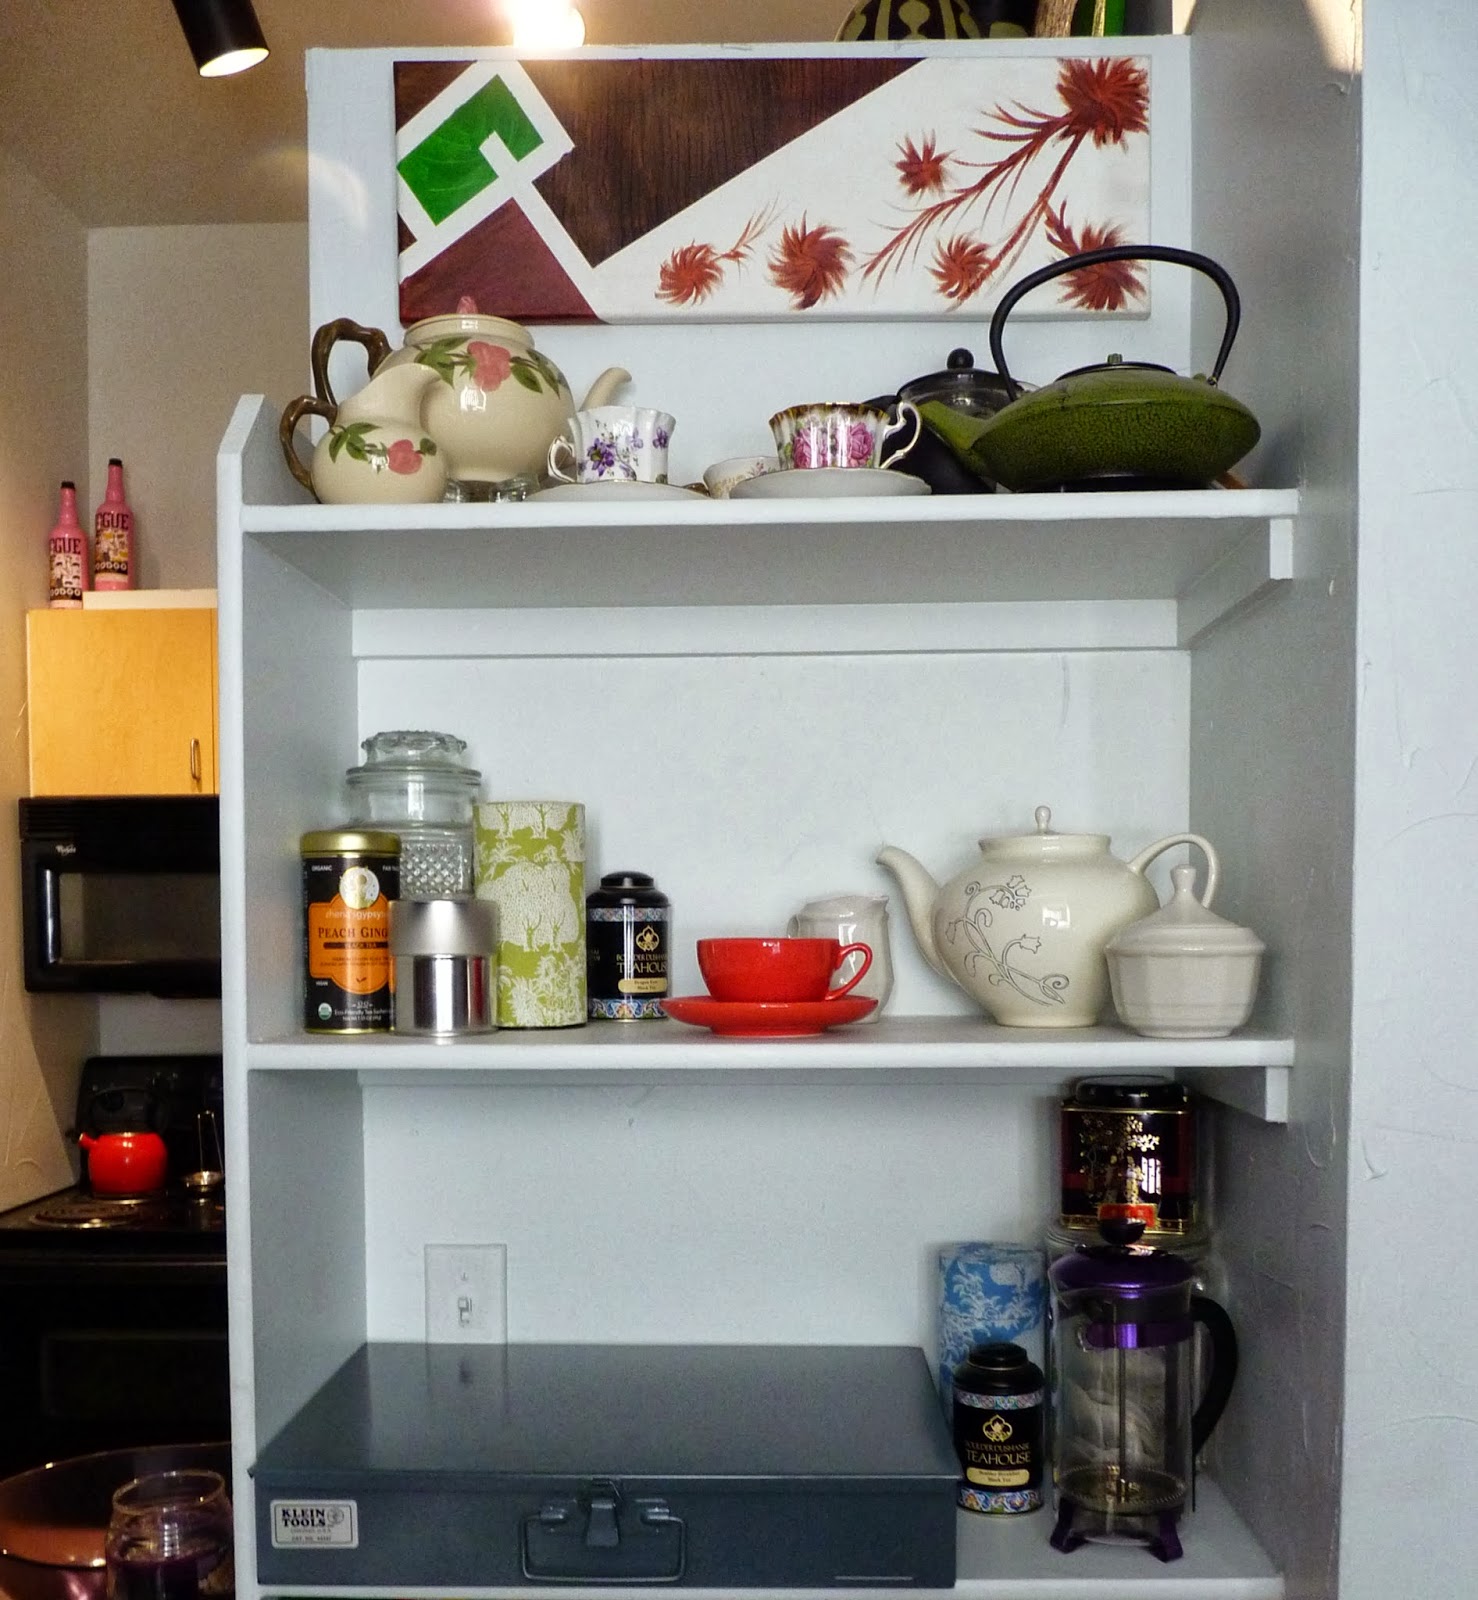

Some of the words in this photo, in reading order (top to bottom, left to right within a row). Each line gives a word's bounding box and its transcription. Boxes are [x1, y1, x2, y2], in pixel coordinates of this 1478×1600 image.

[318, 927, 355, 938] PEACH
[361, 927, 388, 938] GING
[616, 953, 646, 961] BODER
[616, 961, 667, 973] TAHOUS
[965, 1448, 1031, 1465] TEAHOUSE
[282, 1509, 325, 1518] KLEIN
[282, 1518, 326, 1527] TOOLS
